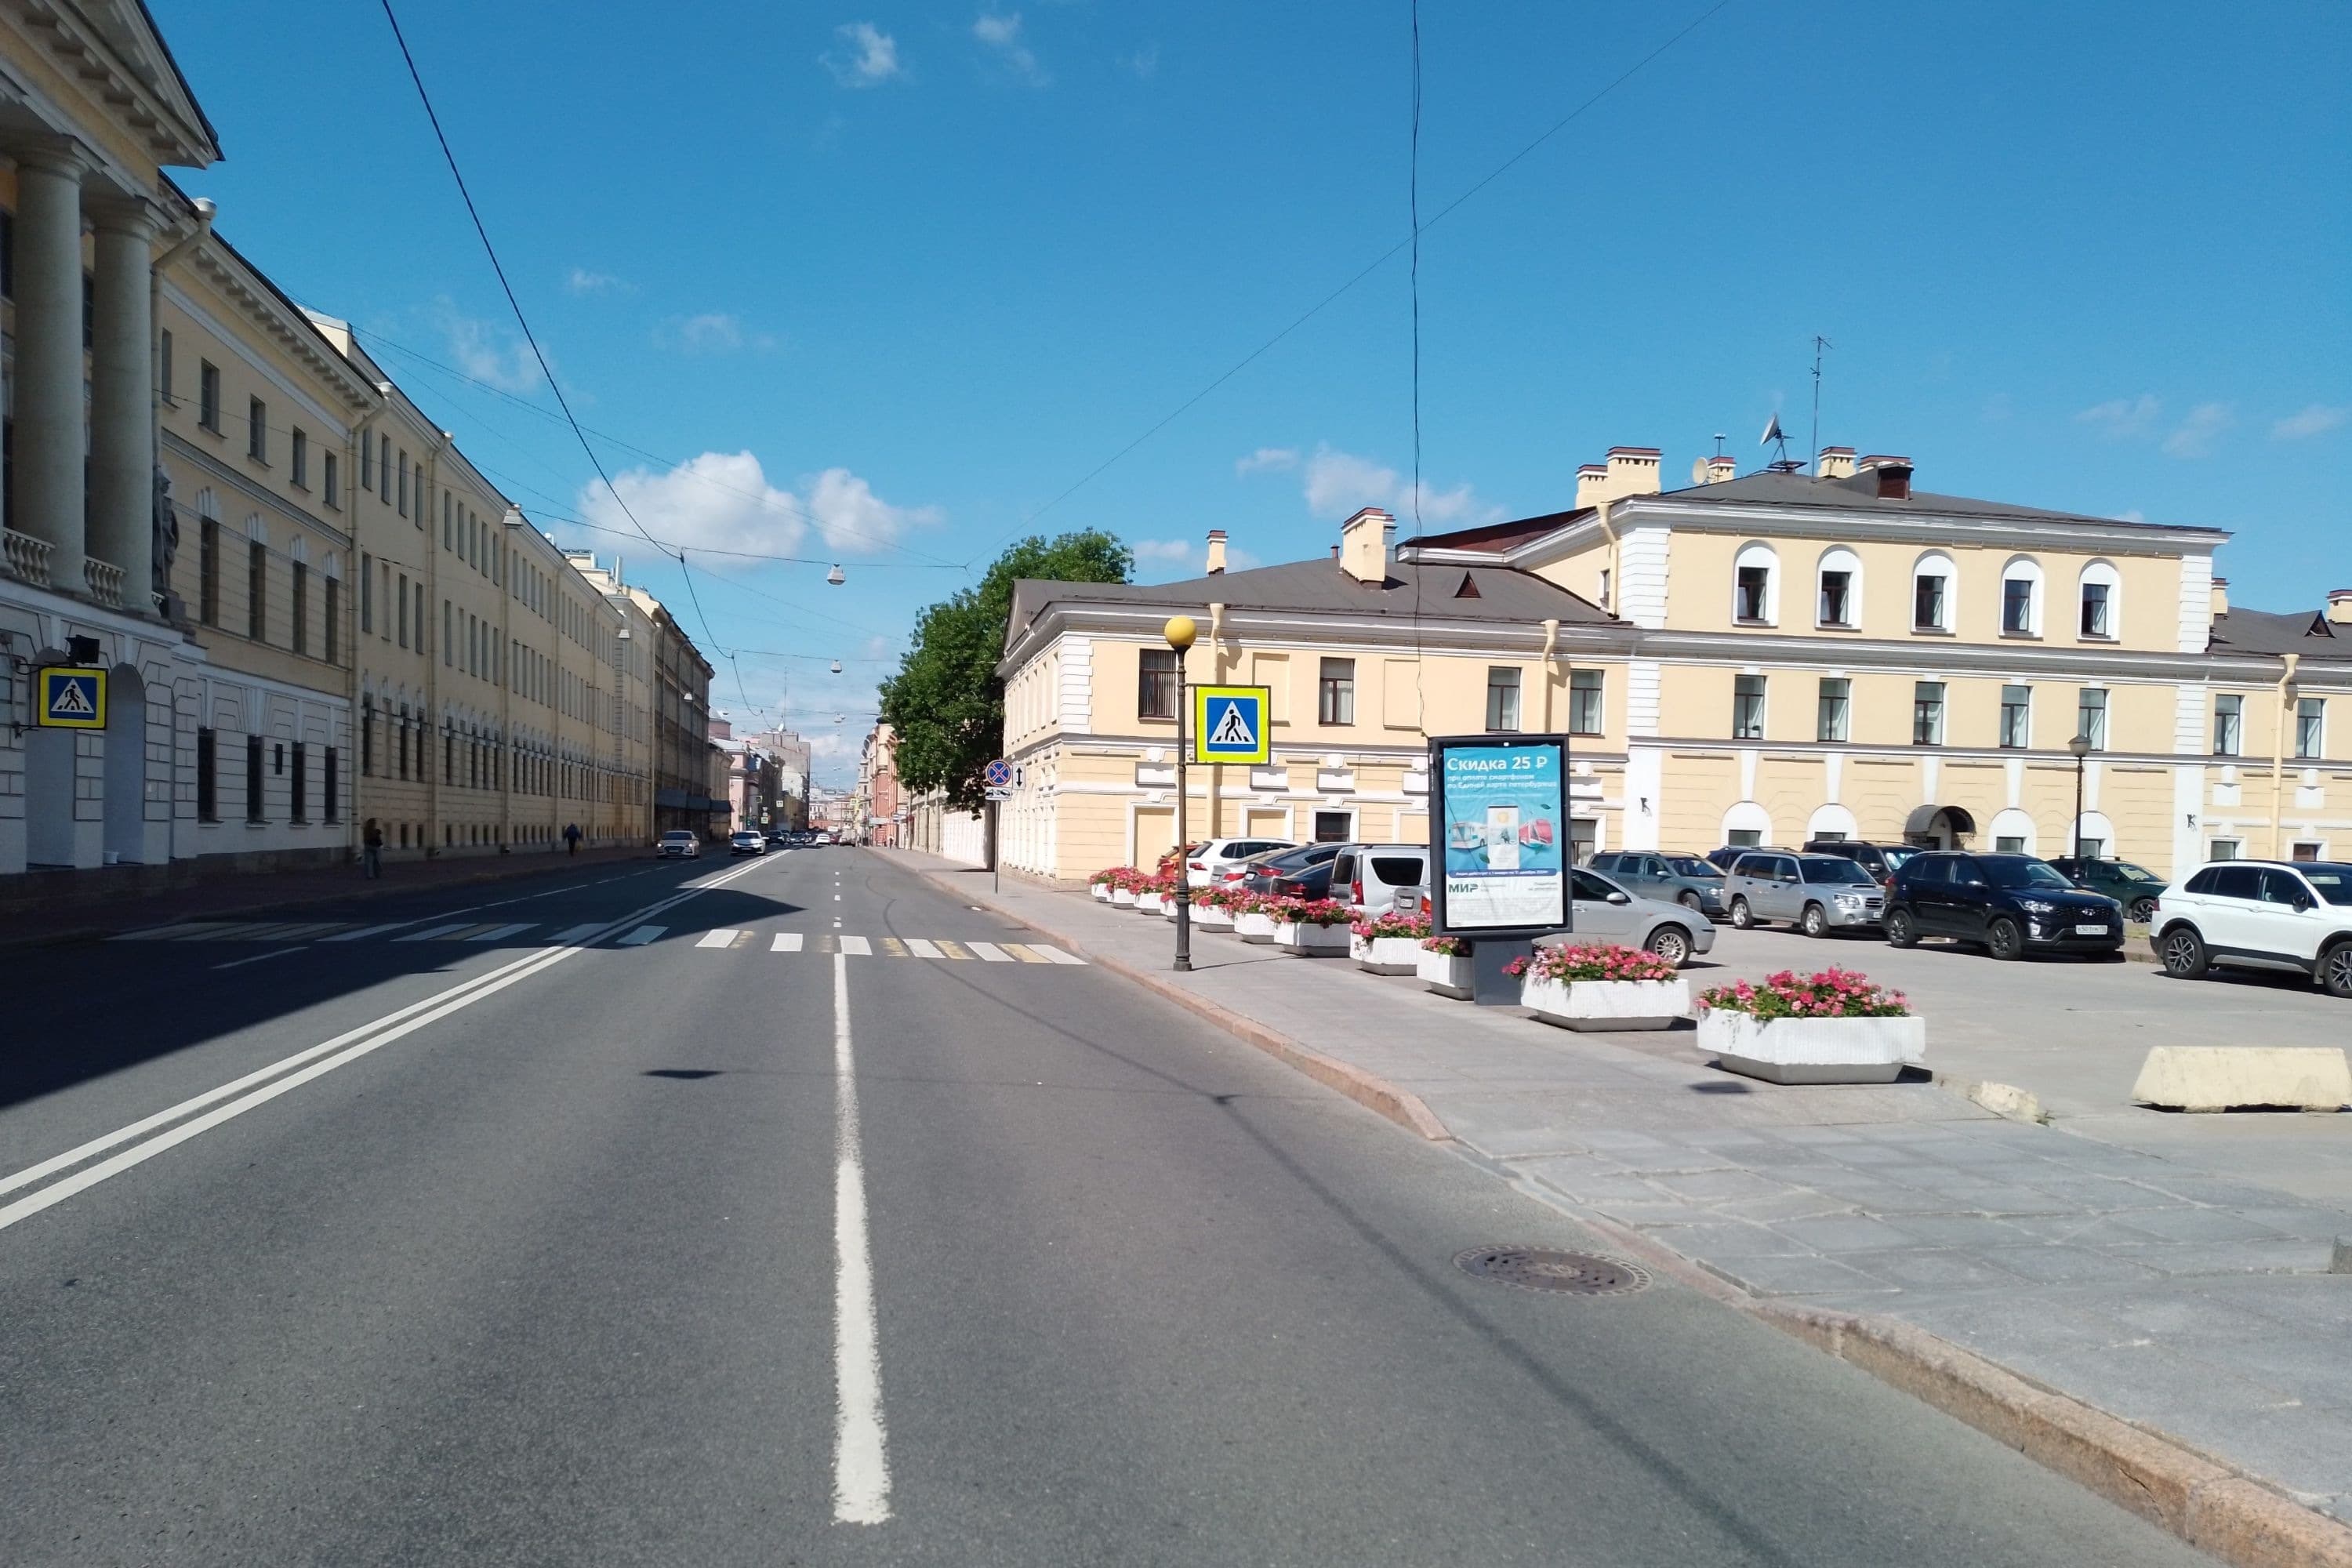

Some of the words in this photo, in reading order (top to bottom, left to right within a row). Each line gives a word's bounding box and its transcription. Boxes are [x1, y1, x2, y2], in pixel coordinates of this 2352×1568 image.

[1447, 757, 1507, 771] Скидка
[1512, 757, 1530, 769] 25
[1448, 883, 1479, 893] МИР
